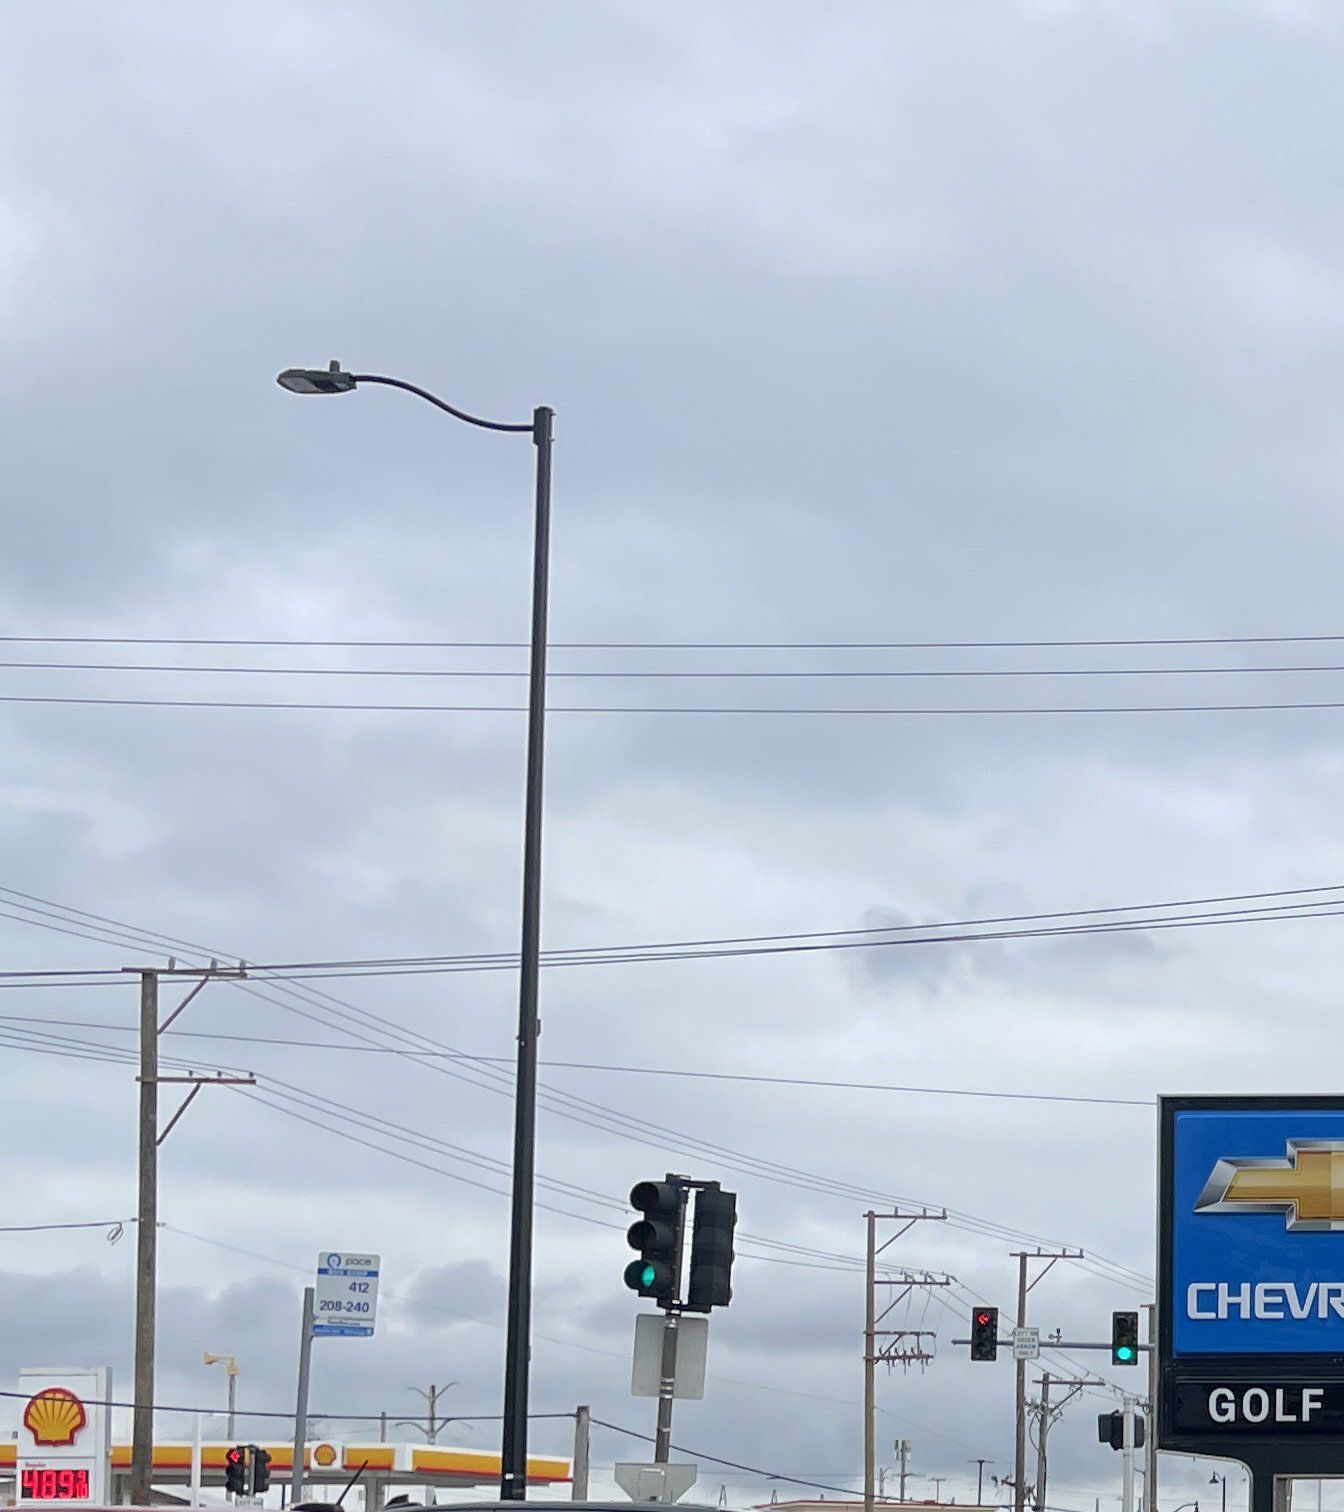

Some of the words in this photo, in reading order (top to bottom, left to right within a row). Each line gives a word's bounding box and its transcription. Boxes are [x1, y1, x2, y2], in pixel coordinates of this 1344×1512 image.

[348, 1281, 370, 1294] 412
[319, 1299, 370, 1314] 208-240
[1207, 1387, 1325, 1423] GOLF
